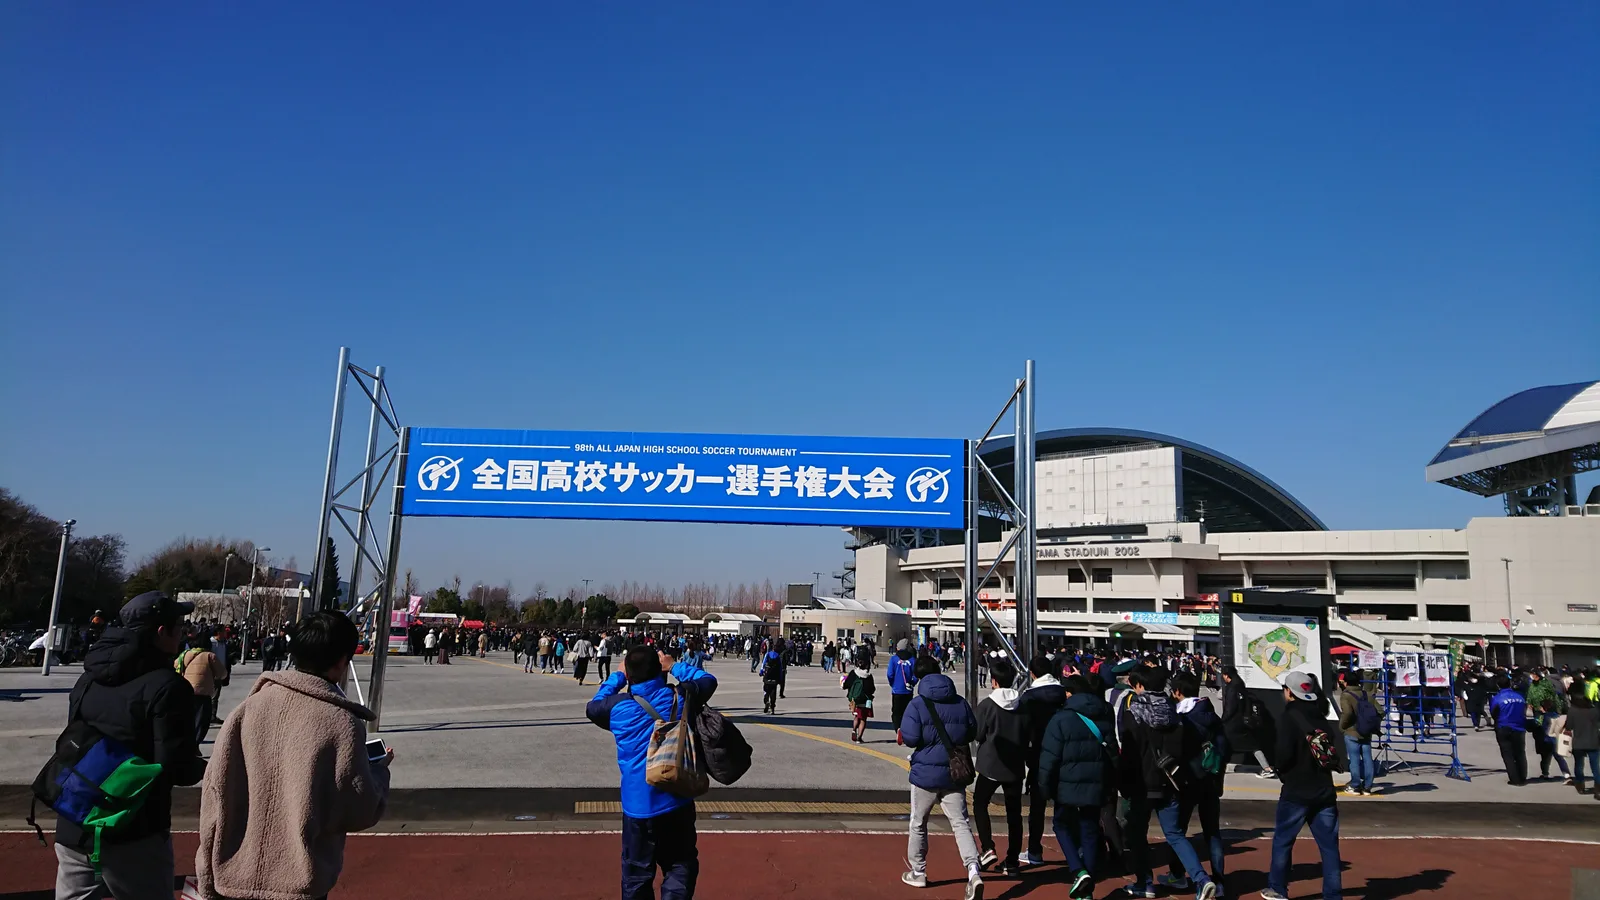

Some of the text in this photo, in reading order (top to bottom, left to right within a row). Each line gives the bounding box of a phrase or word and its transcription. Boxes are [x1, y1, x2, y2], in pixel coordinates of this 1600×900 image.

[574, 443, 798, 456] 98th ALL JAPAN HIGH SCHOOL SOCCER TOURNAMENT
[472, 458, 897, 500] 全国高校サッカー選手権大会
[1064, 546, 1109, 558] STADIUM
[1114, 545, 1141, 557] 2002
[1396, 655, 1418, 669] 南門
[1425, 655, 1447, 669] 北門
